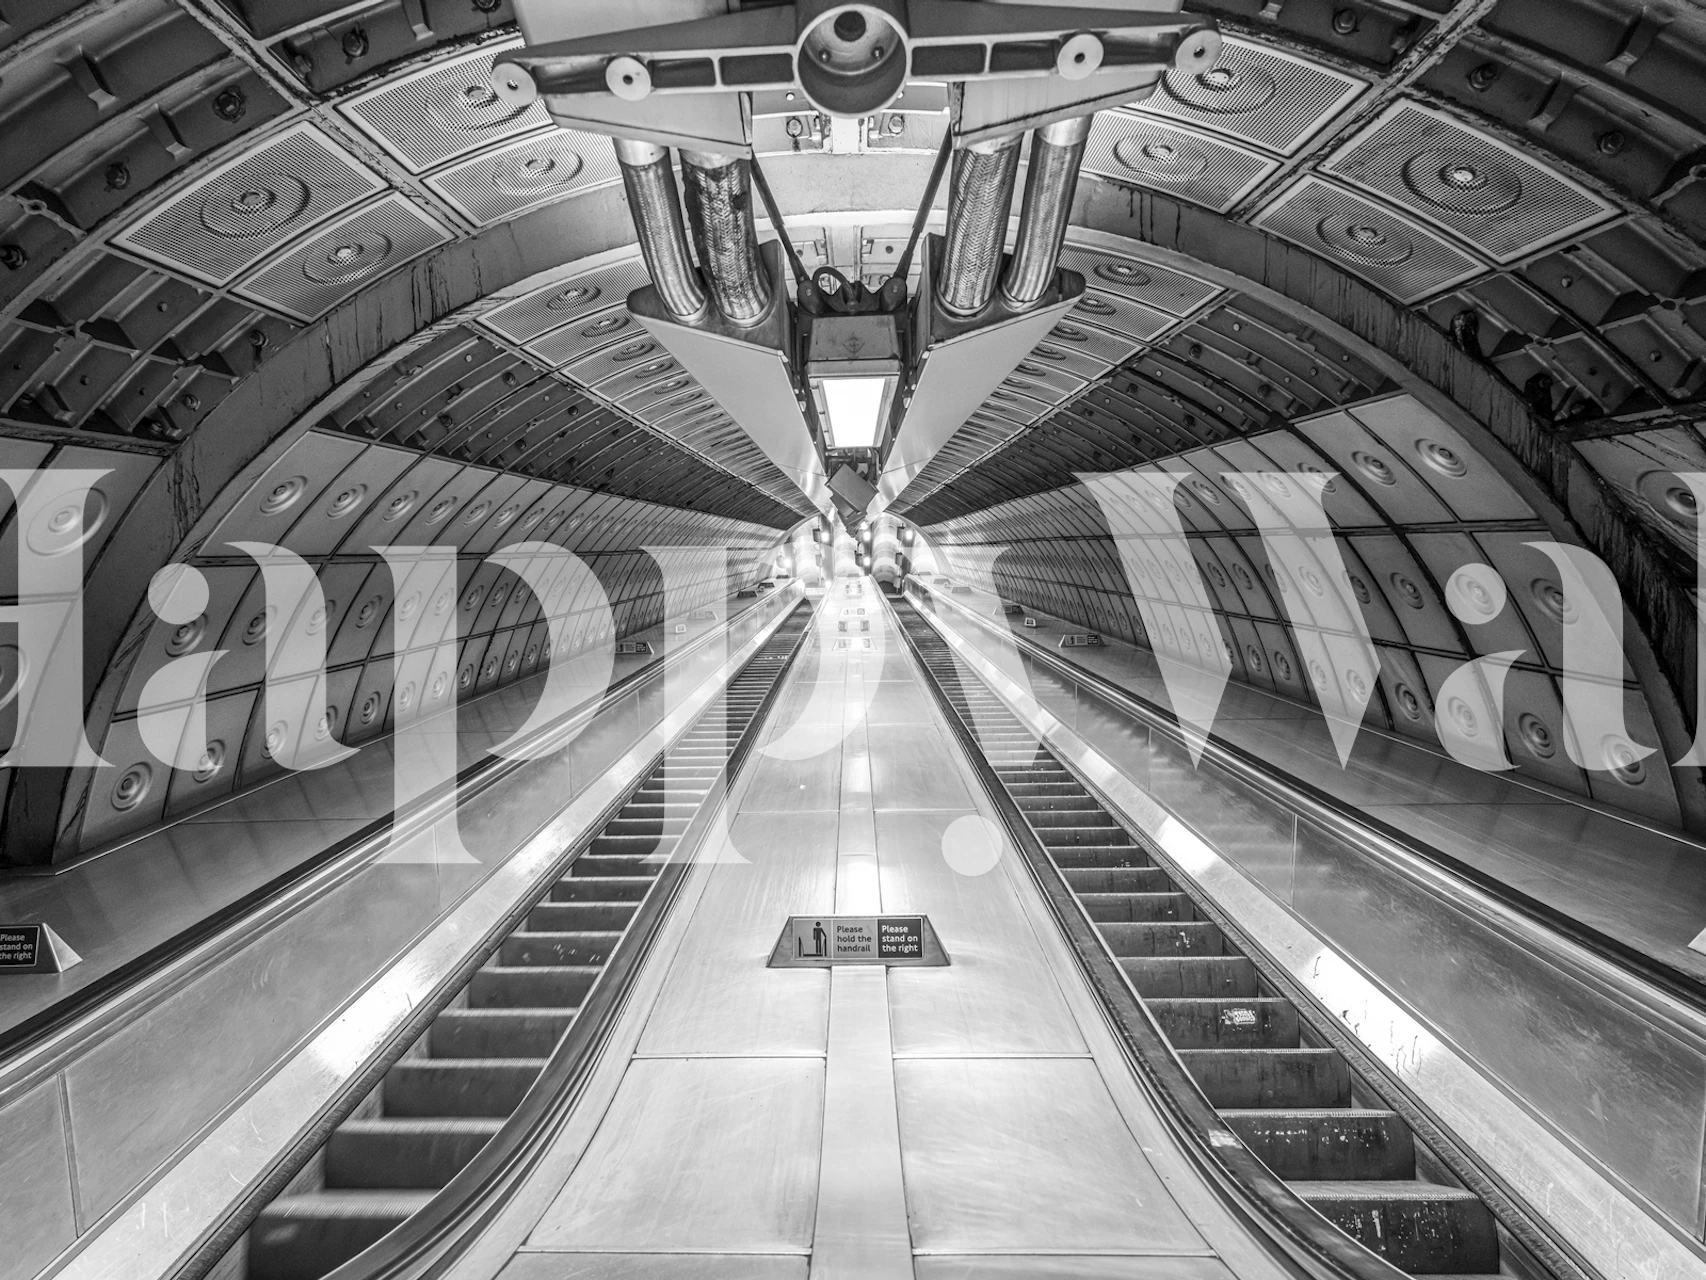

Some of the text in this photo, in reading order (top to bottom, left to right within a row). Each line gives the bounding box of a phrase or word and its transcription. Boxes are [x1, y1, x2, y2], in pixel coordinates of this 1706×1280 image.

[881, 925, 908, 933] Please
[0, 933, 26, 941] Please
[881, 935, 905, 943] stand
[0, 943, 21, 951] stand
[882, 944, 919, 954] the right
[13, 951, 32, 961] right
